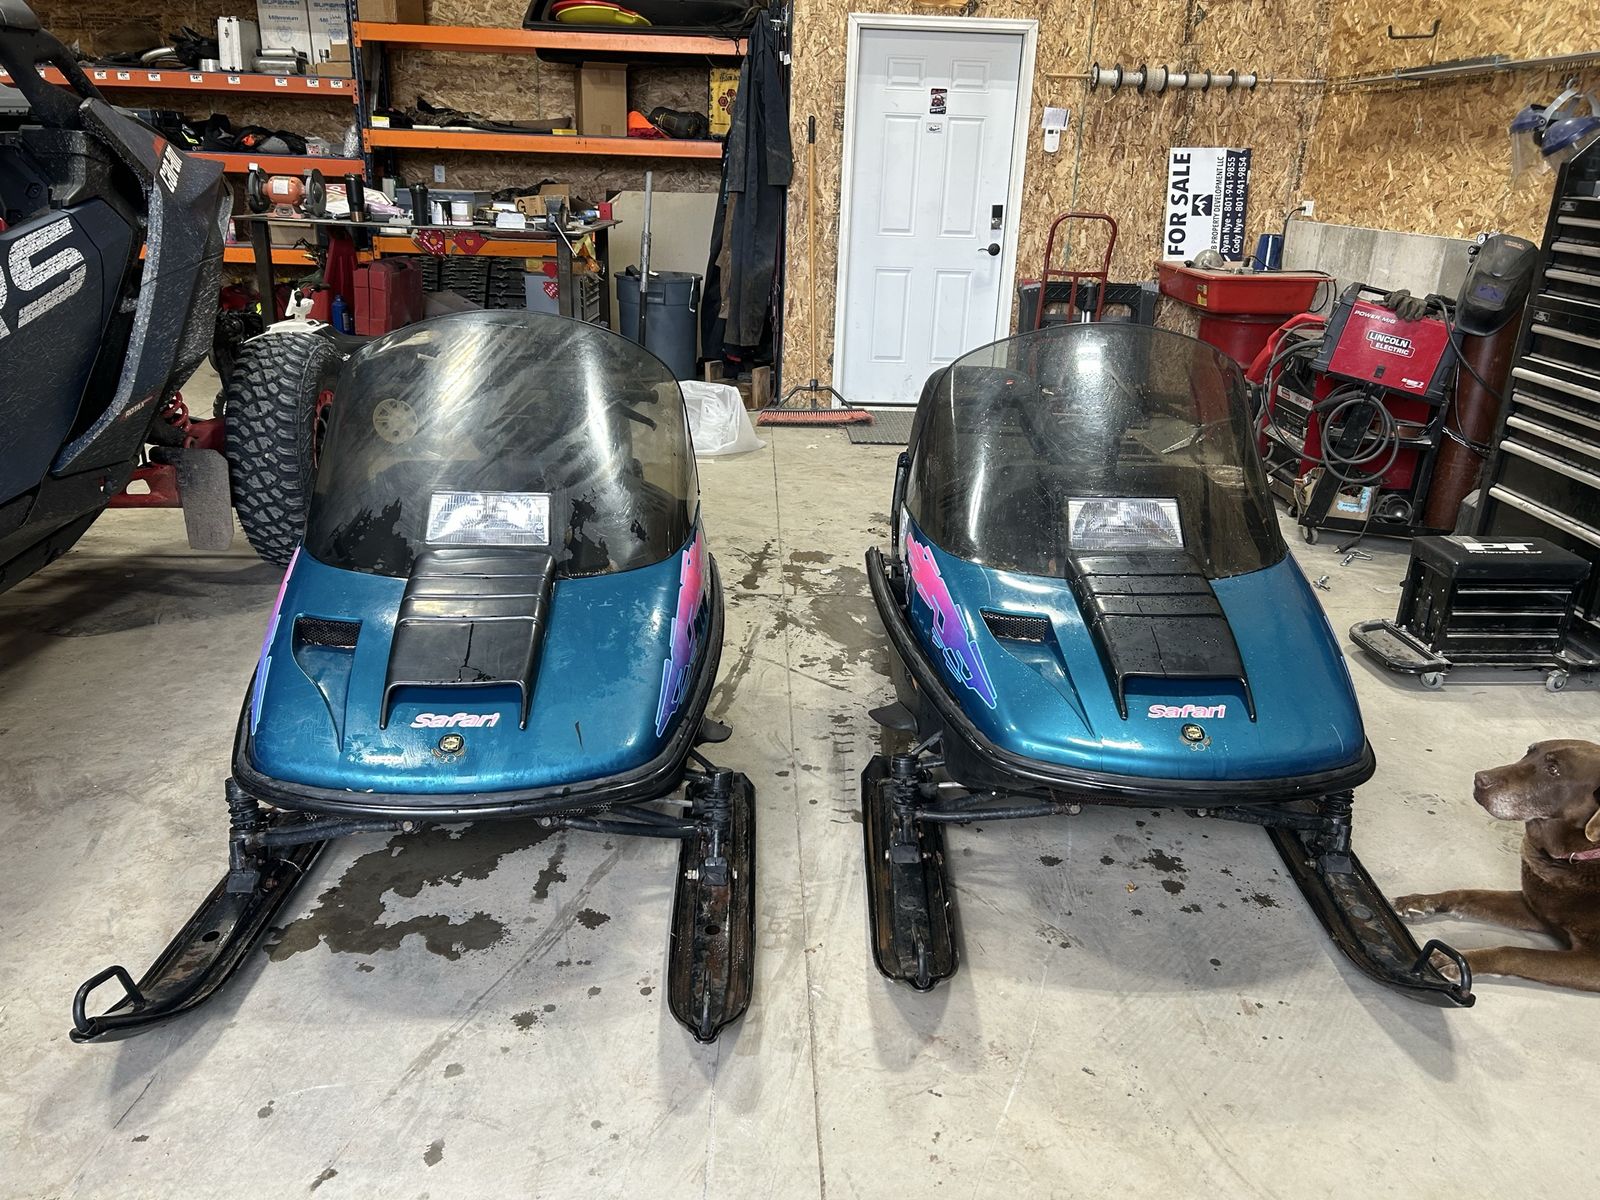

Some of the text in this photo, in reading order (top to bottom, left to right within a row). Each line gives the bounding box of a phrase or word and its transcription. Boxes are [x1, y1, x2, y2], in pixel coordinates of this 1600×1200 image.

[1217, 156, 1225, 168] LLC
[1214, 168, 1224, 213] DEVELOPMENT
[1167, 153, 1191, 256] FOR SALE
[1221, 156, 1236, 254] Ryan Nye 801-941-9855
[1231, 156, 1247, 254] Cody Nye 801-941-9854
[1211, 213, 1221, 245] PROPERTY
[0, 216, 87, 339] S
[1354, 310, 1381, 320] POWER
[1369, 332, 1409, 348] LINCOLN
[1375, 342, 1410, 356] ELECTRIC
[410, 712, 500, 728] Safari
[1148, 704, 1227, 719] Safari
